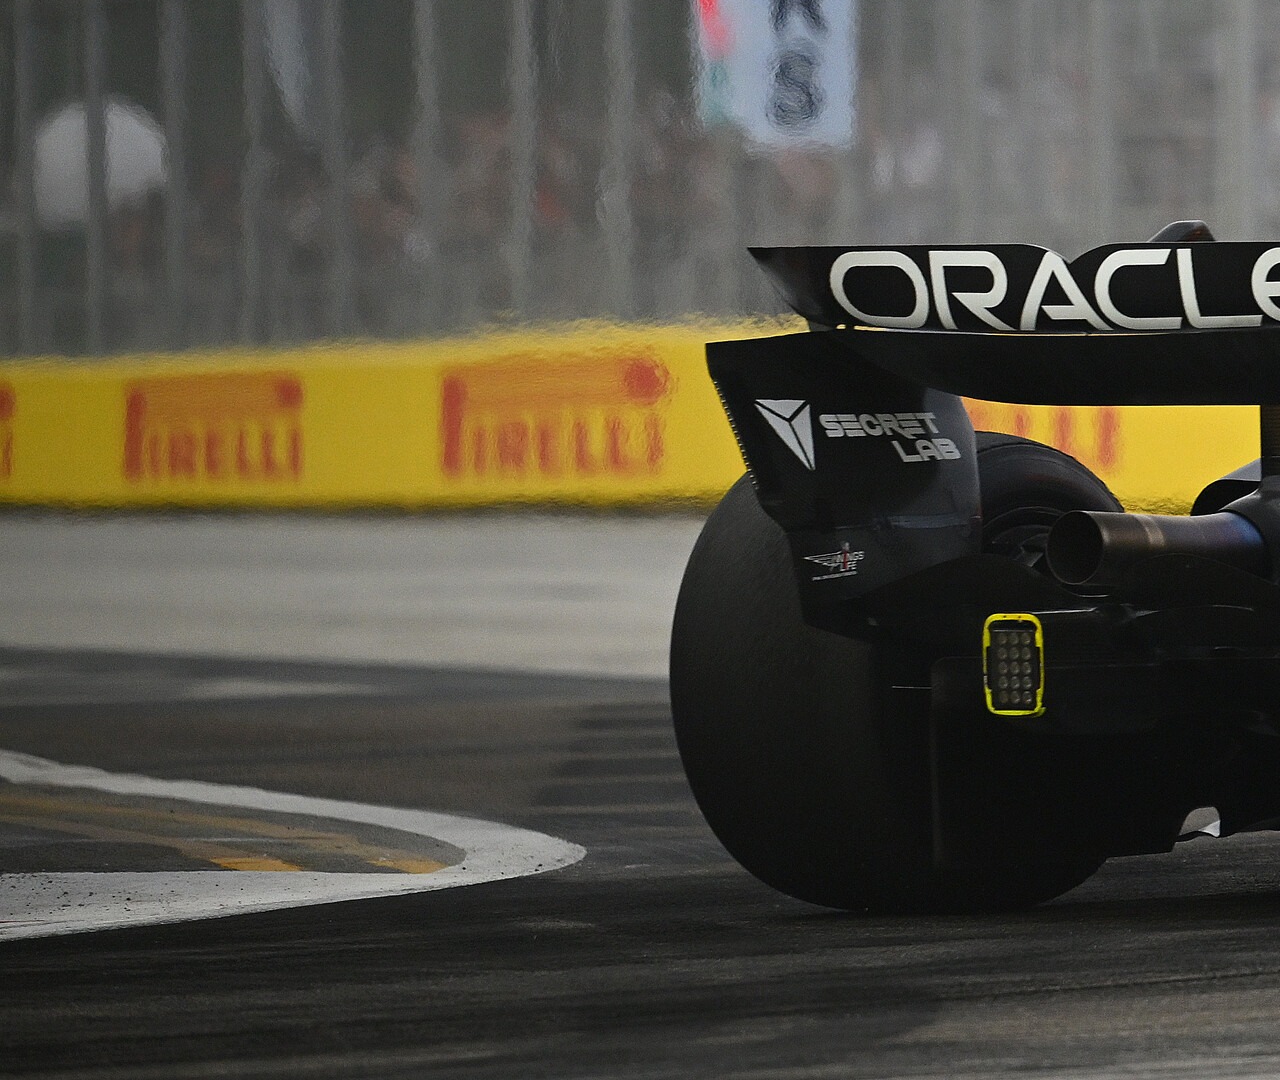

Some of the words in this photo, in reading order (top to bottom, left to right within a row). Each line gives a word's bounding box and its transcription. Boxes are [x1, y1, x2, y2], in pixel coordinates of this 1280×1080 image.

[440, 354, 676, 477] PIRELLI
[818, 412, 940, 439] SECRET
[891, 437, 961, 463] LAB
